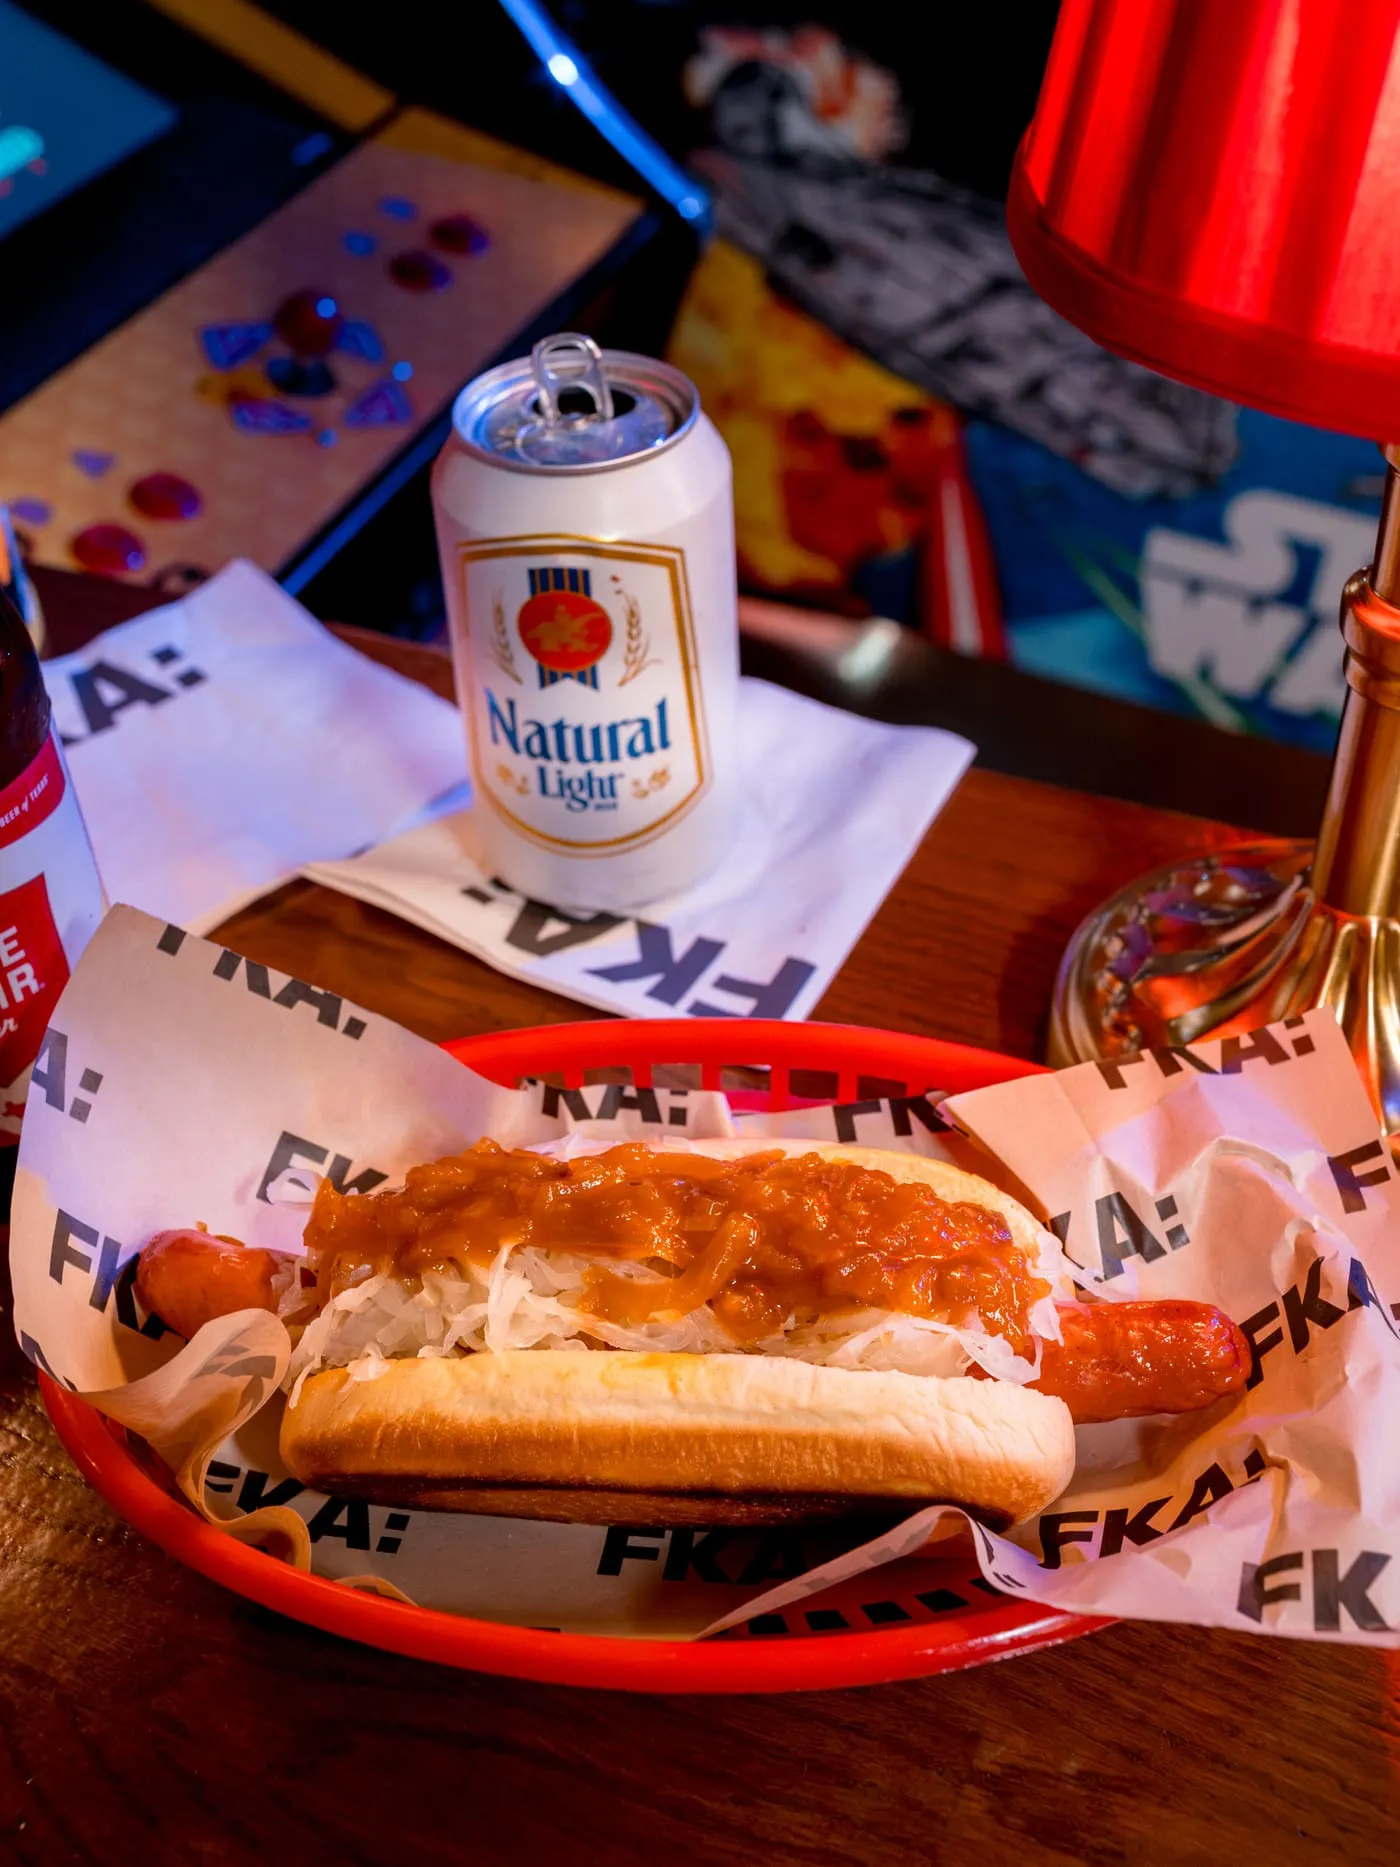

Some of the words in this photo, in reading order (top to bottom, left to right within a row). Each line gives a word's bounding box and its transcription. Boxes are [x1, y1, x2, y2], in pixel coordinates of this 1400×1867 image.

[62, 643, 205, 745] A:
[484, 686, 671, 764] Natural
[29, 772, 48, 801] TEXAS
[538, 766, 617, 812] Light
